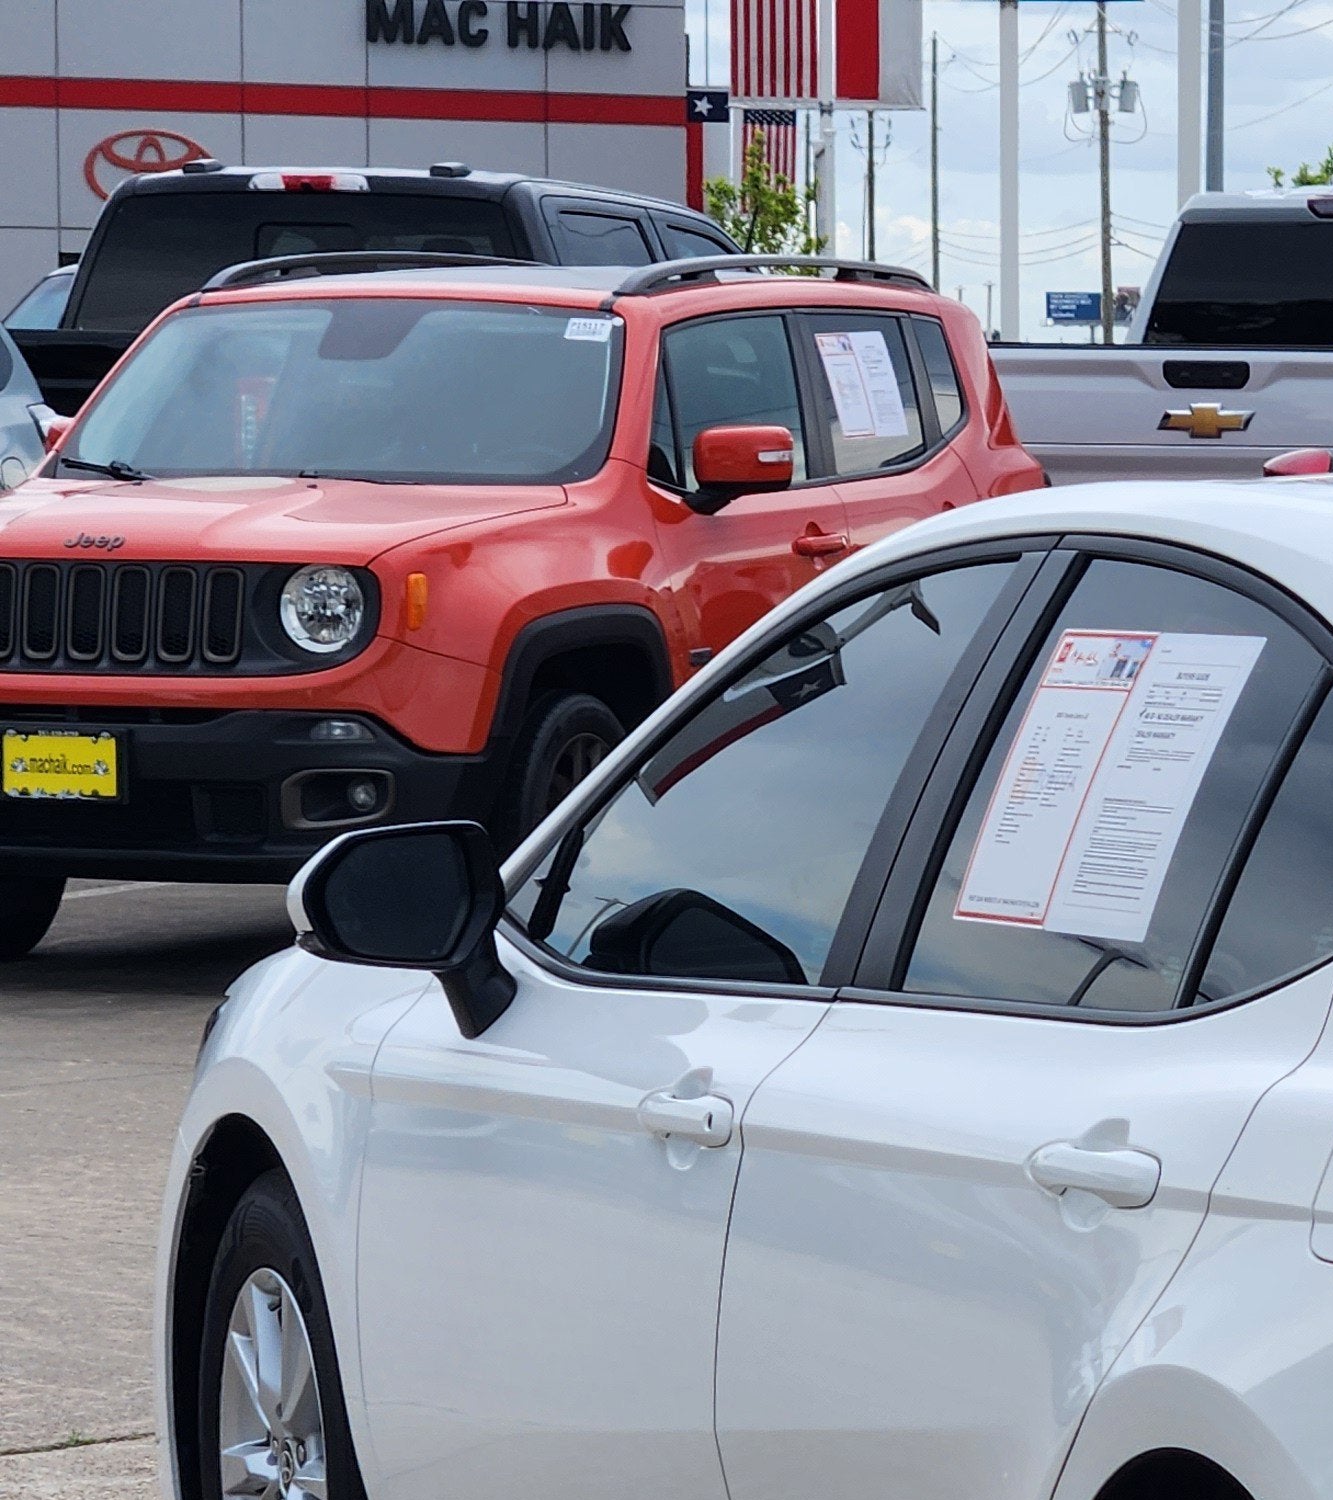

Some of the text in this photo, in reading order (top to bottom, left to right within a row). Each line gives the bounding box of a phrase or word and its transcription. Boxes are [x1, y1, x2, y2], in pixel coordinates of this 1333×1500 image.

[366, 0, 632, 51] MAC HAIK
[63, 532, 126, 552] Jeep
